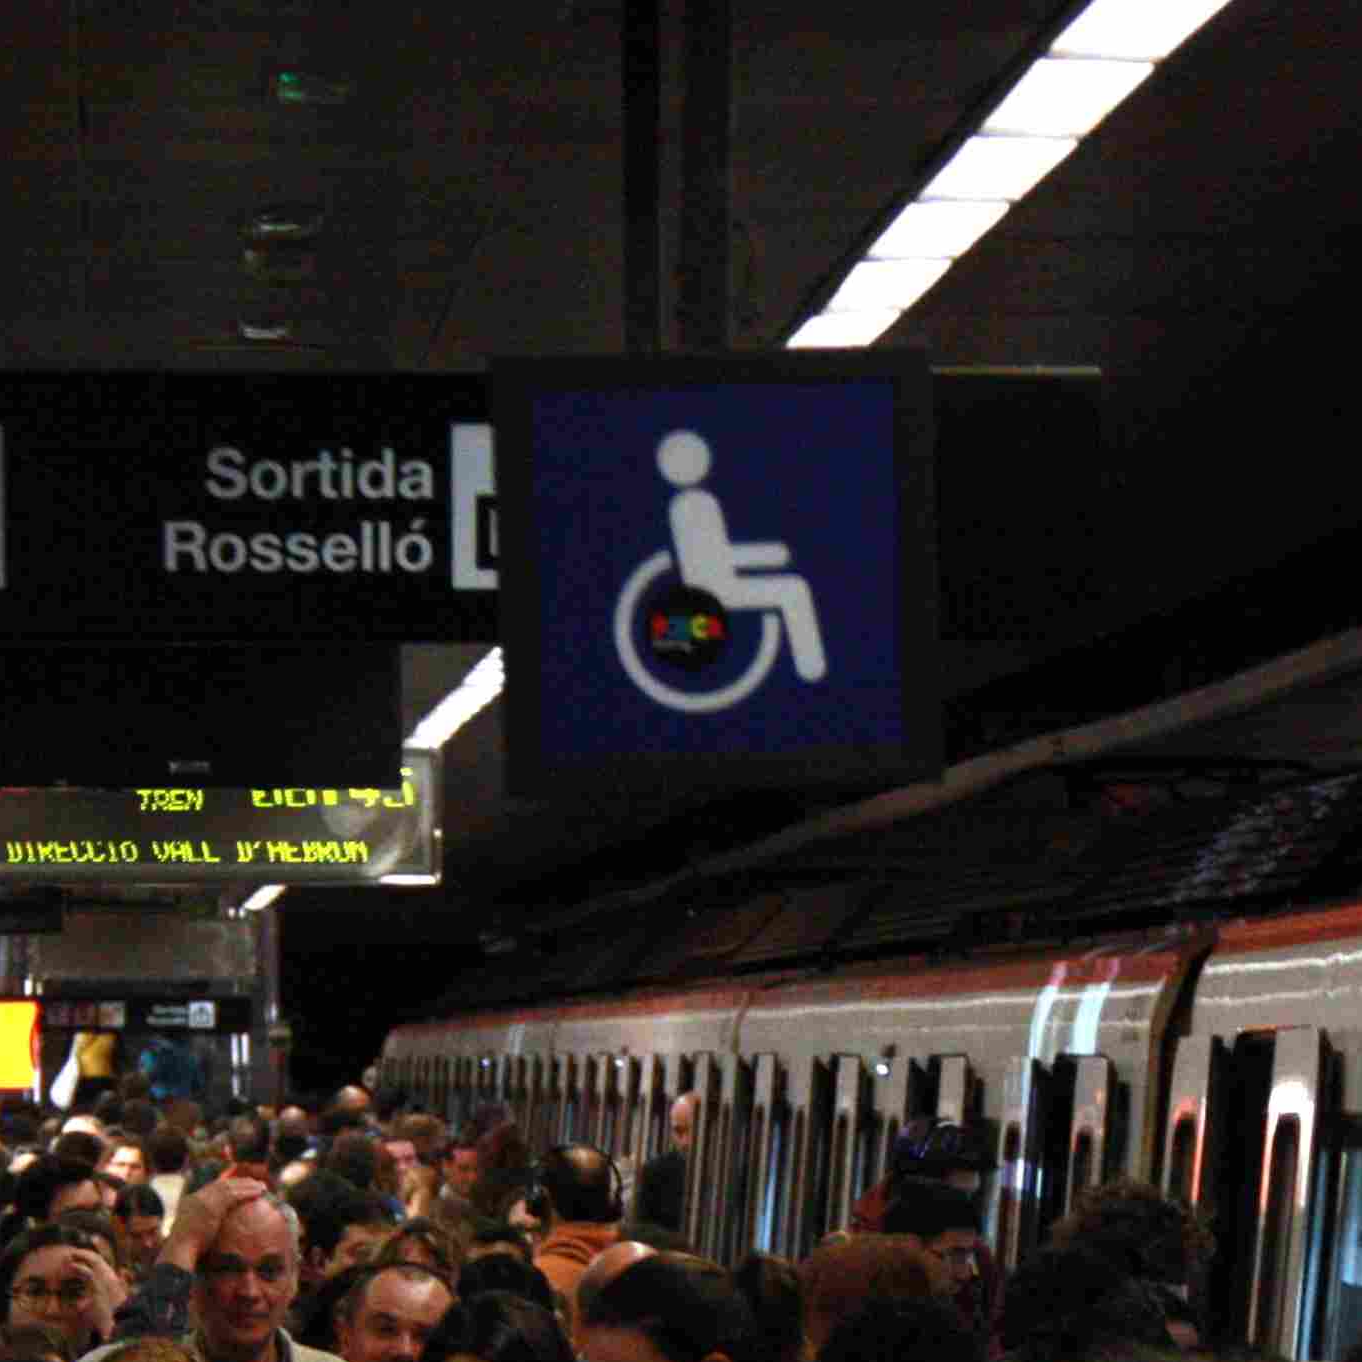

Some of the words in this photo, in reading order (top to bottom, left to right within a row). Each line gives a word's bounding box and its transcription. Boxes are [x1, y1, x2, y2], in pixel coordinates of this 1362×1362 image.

[204, 444, 435, 502] Sortida
[161, 515, 435, 574] Rosselló
[152, 840, 222, 863] VALL
